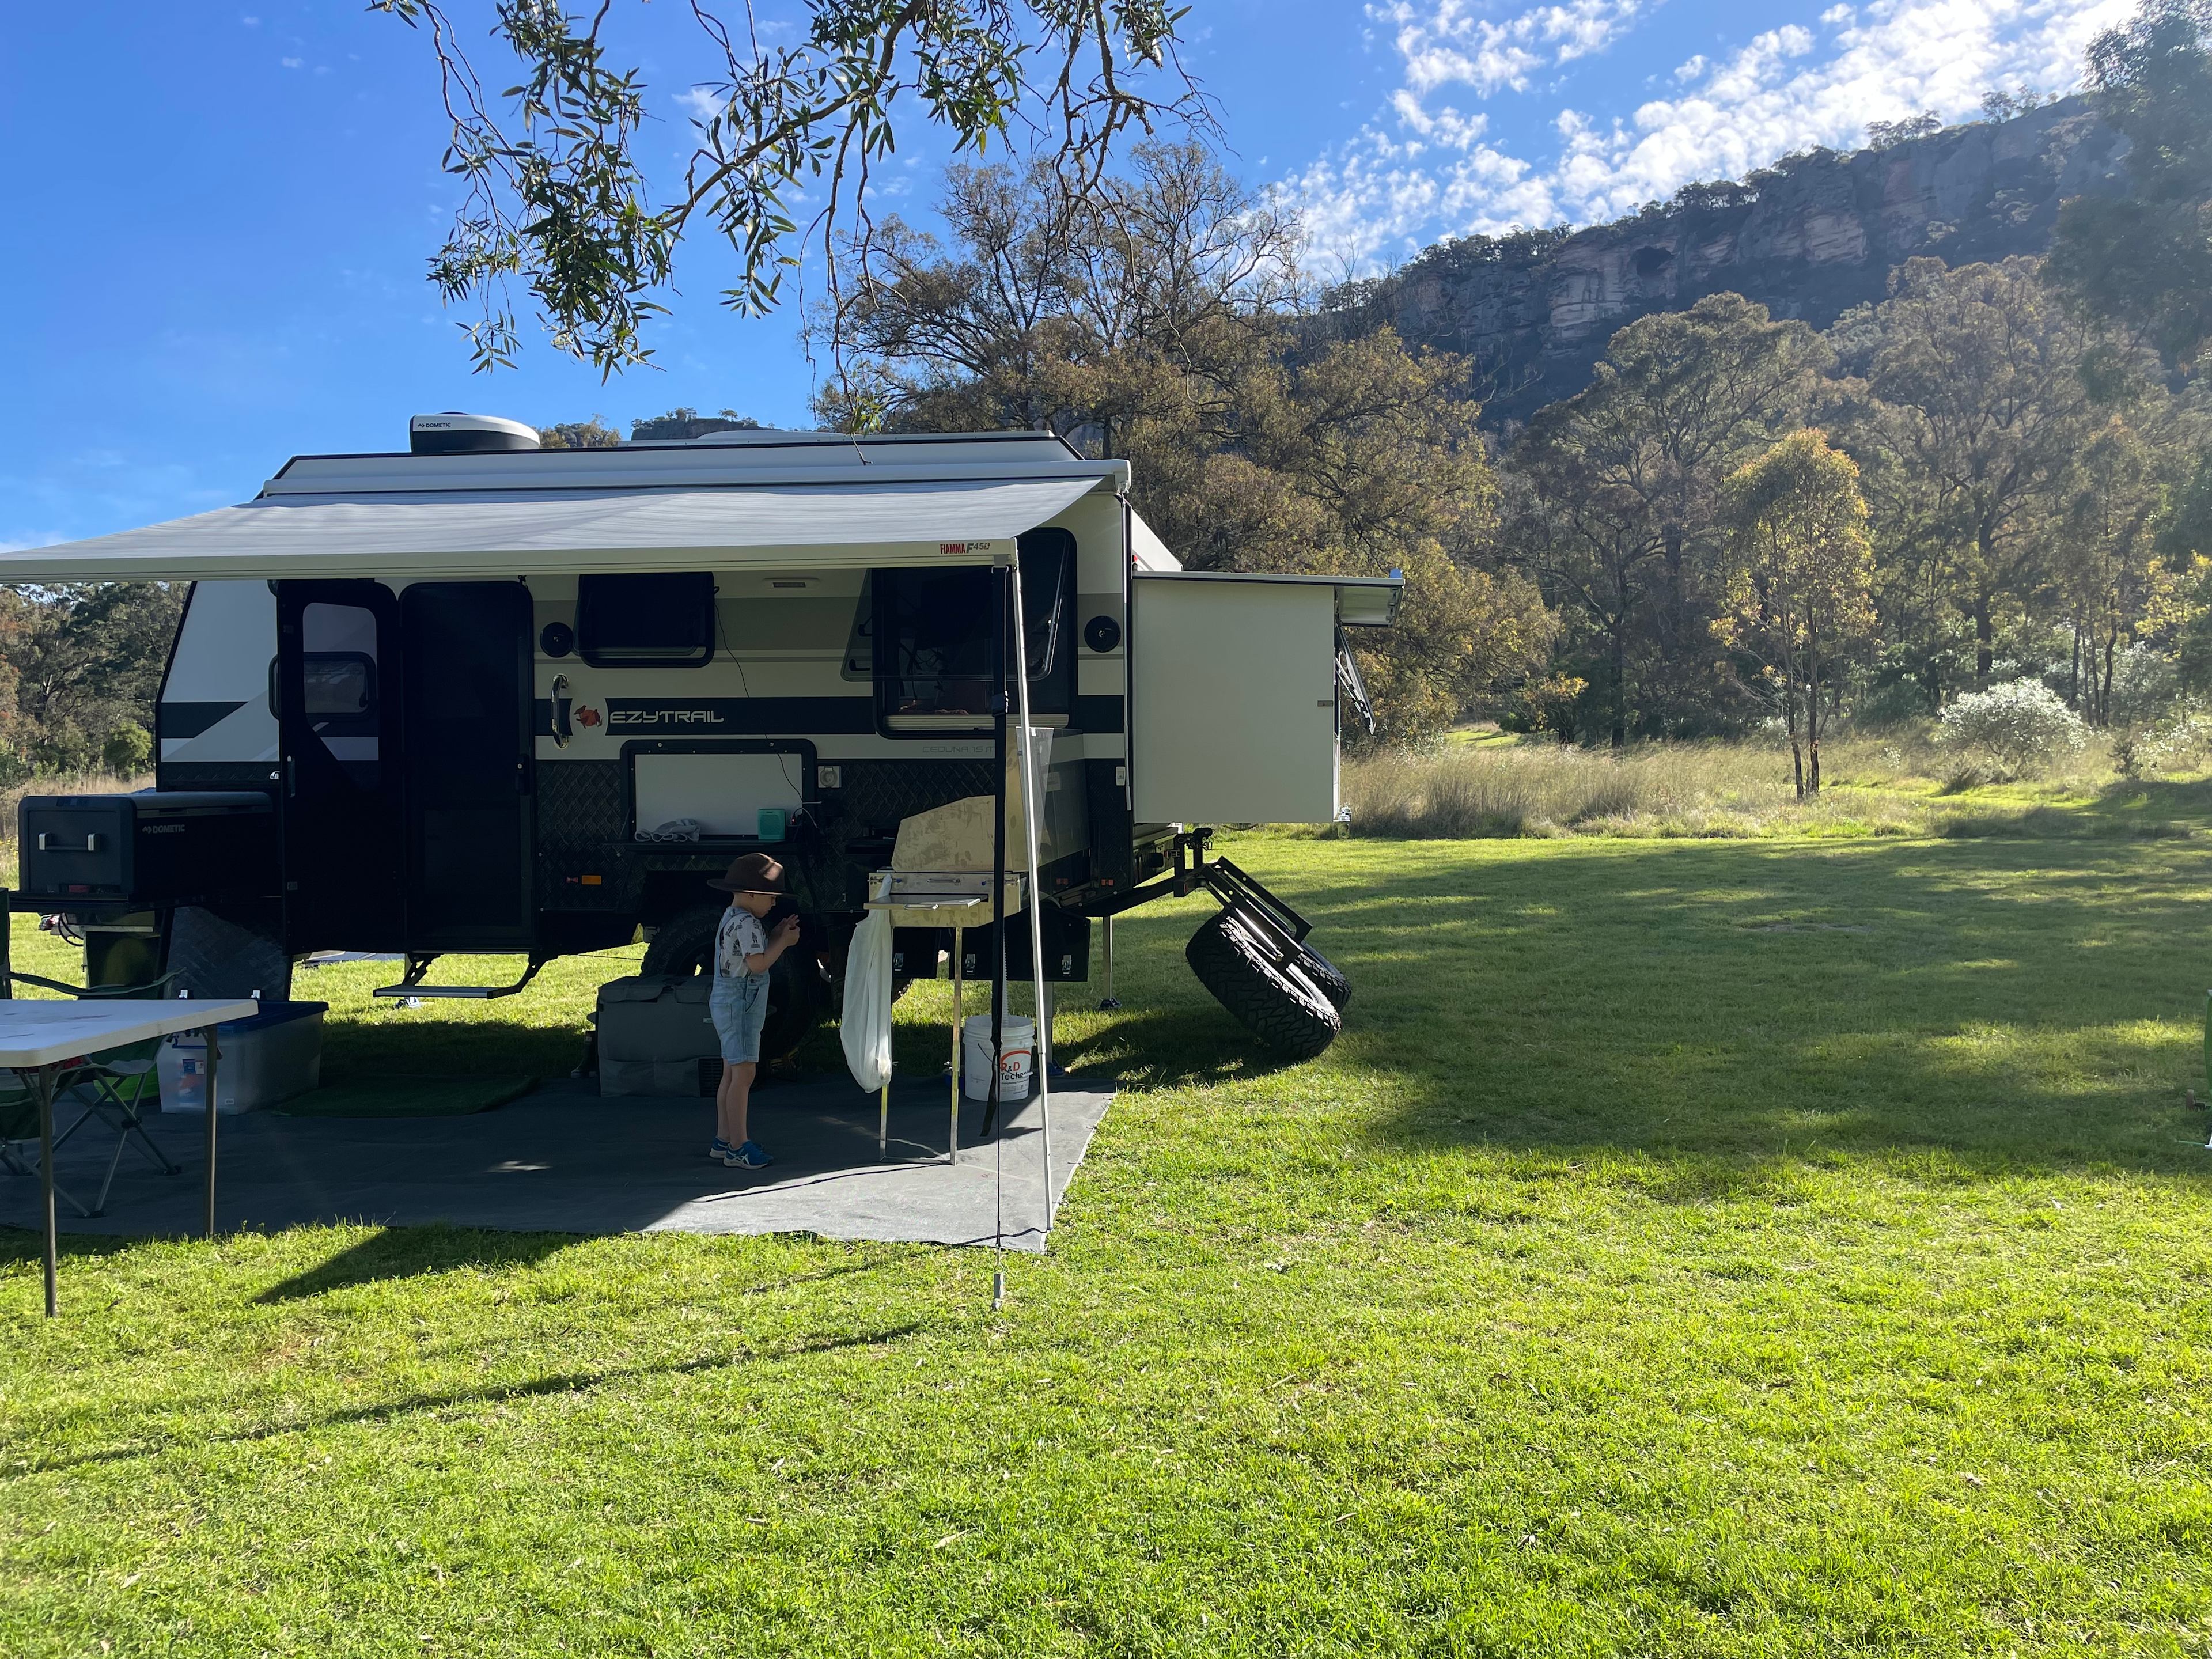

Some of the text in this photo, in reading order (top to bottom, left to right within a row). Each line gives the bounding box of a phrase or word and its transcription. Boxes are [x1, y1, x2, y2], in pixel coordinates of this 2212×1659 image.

[940, 543, 965, 554] FIAMMA
[609, 710, 725, 724] EZYTRAIL
[152, 824, 185, 834] DOMETIC
[1000, 1062, 1021, 1072] R&D
